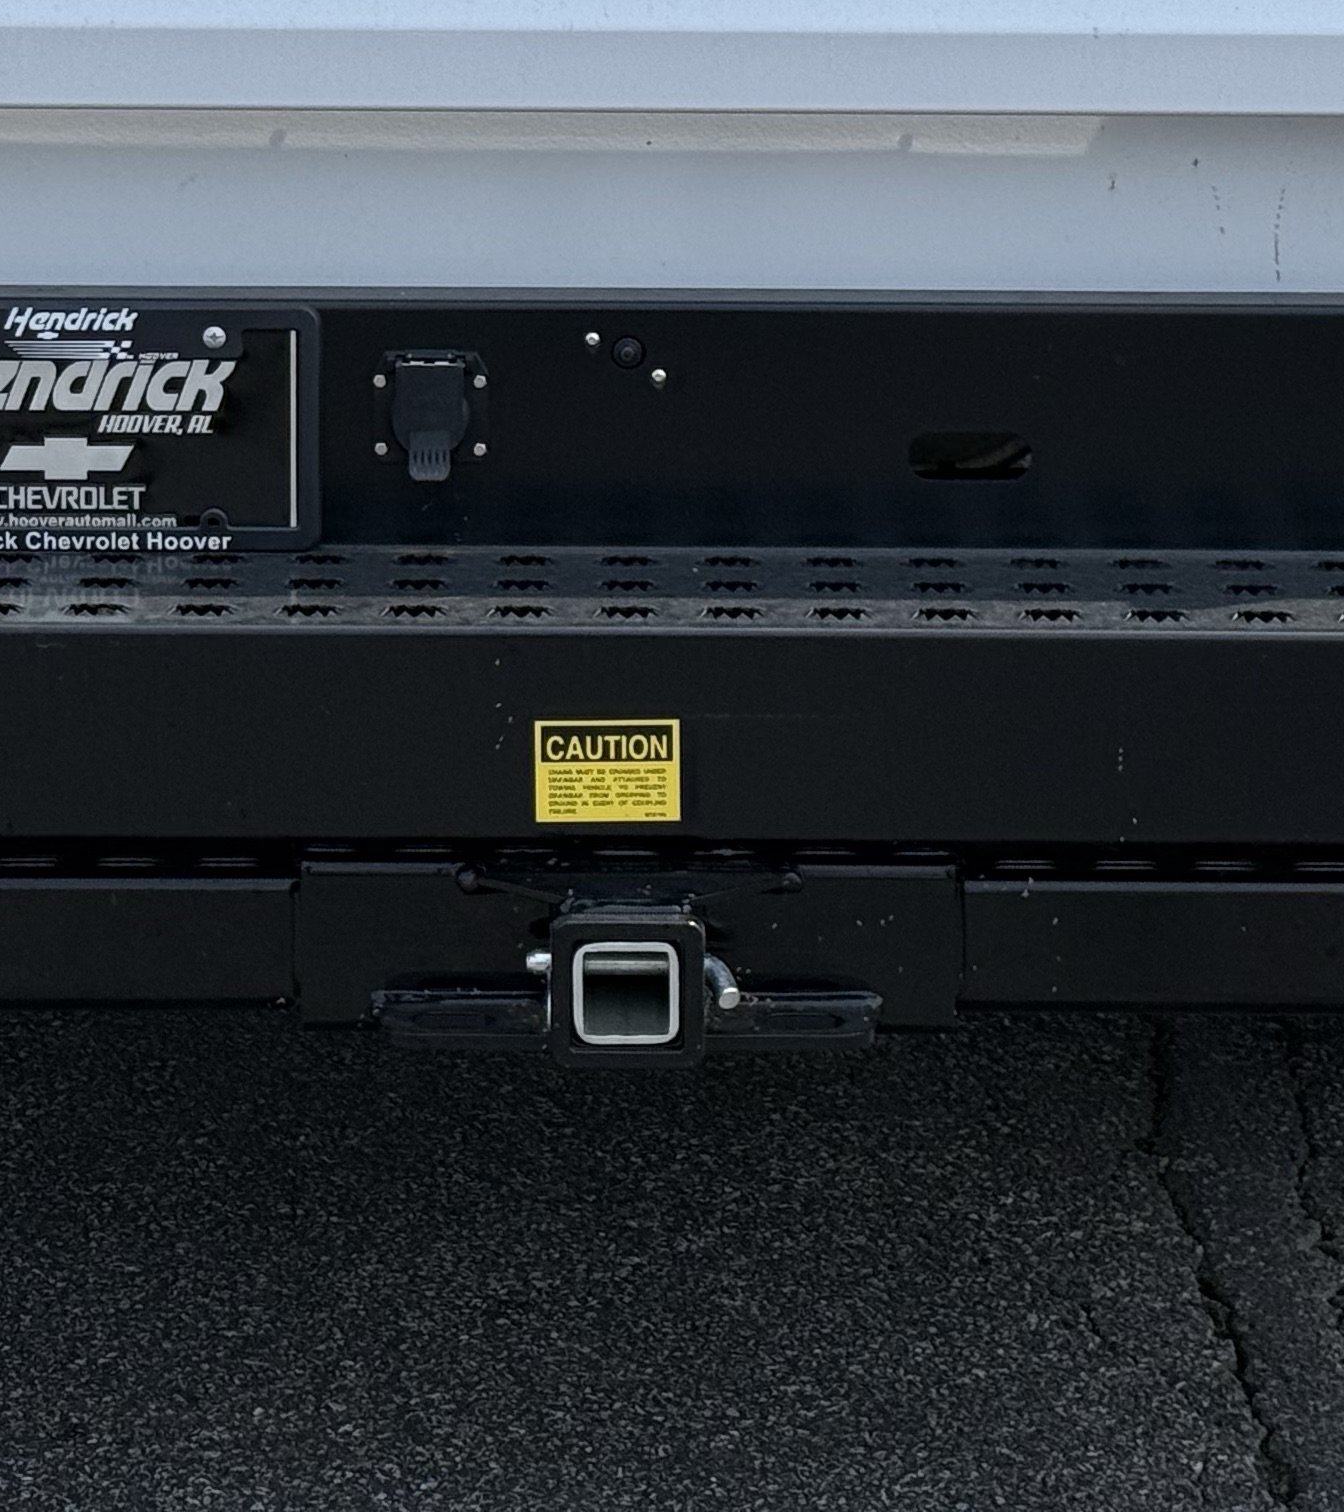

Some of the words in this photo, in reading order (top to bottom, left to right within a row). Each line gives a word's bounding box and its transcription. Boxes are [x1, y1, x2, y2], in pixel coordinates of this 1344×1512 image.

[4, 307, 138, 338] Hendrick
[98, 414, 182, 436] HOOVER,
[186, 415, 215, 435] AL
[25, 530, 140, 551] Chevrolet
[146, 531, 233, 552] Hoover
[546, 734, 668, 760] CAUTION
